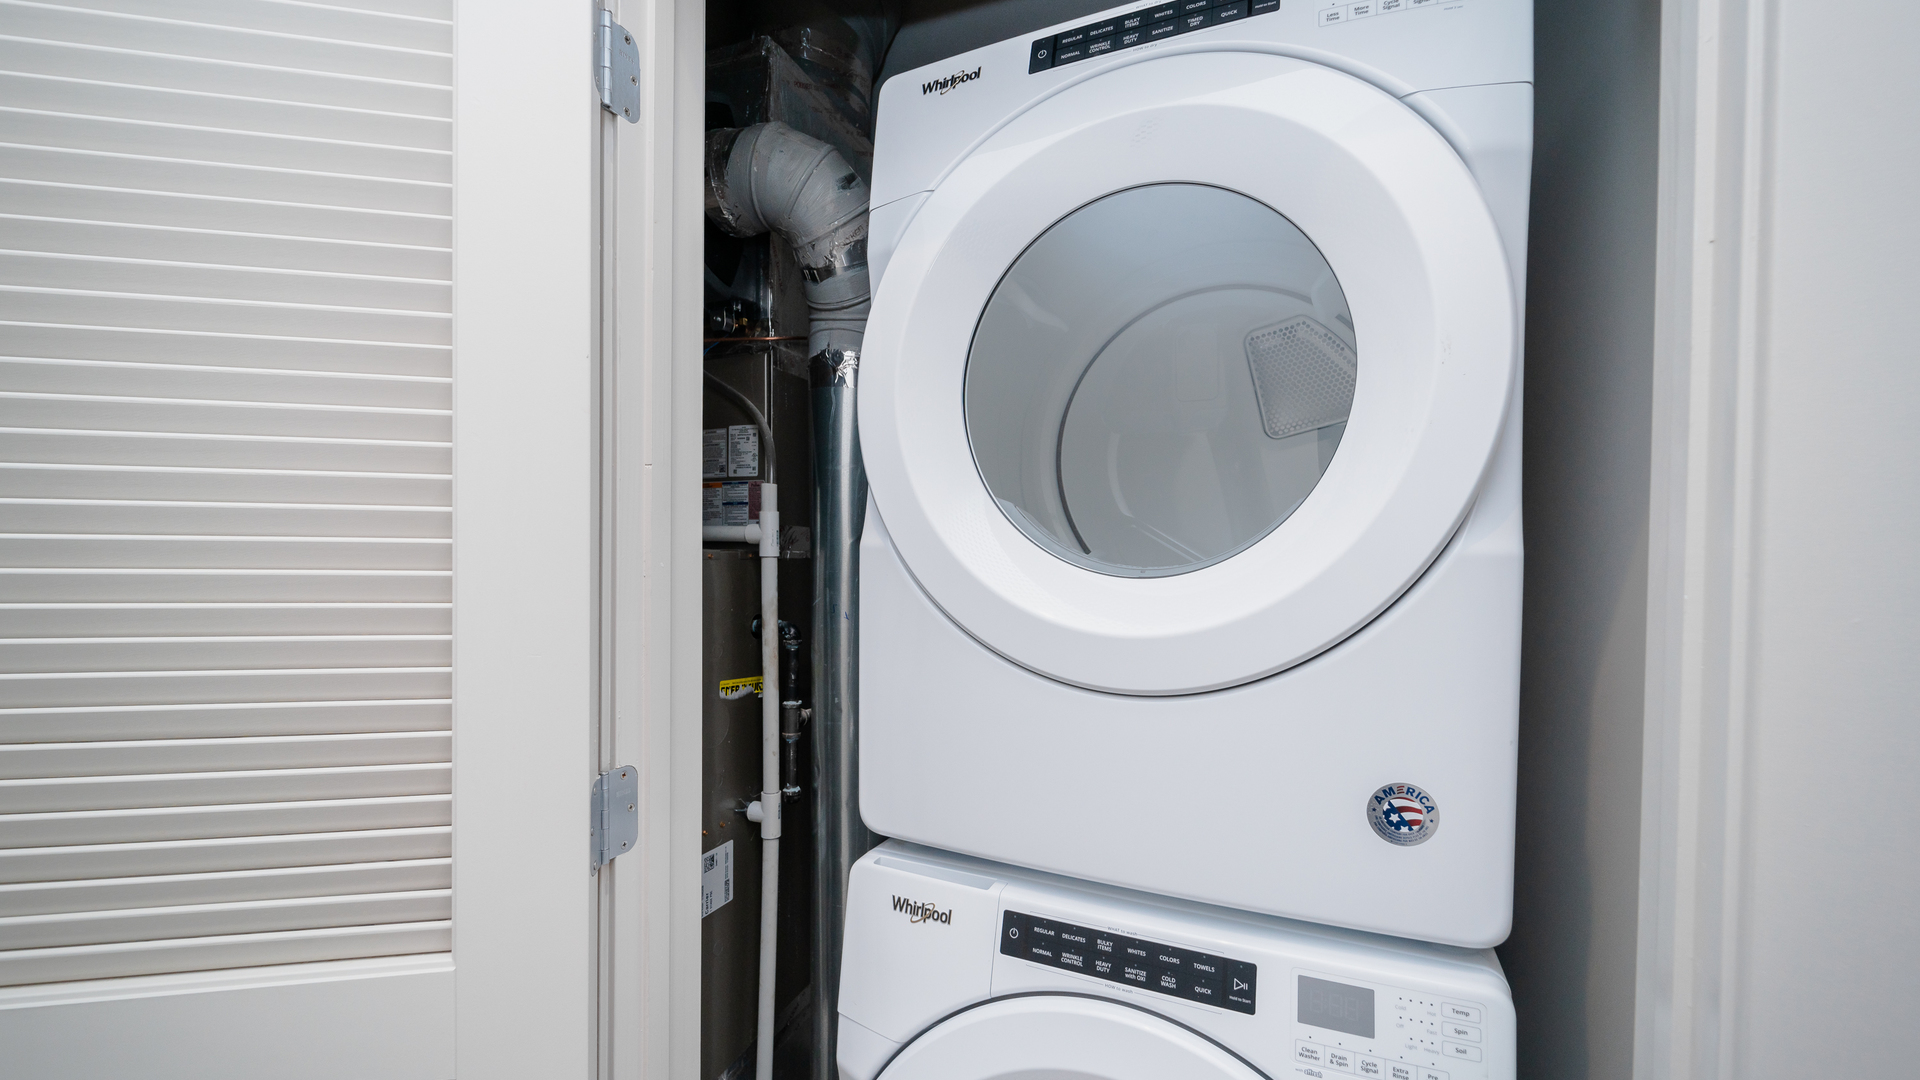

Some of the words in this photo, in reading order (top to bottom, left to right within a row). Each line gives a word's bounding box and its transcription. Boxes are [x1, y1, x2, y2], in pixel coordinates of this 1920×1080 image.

[1185, 0, 1207, 10] COLORS
[1354, 4, 1369, 12] More
[1154, 9, 1173, 18] WHITES
[1220, 9, 1238, 18] QUICK
[1124, 17, 1141, 25] BULKY
[1187, 15, 1204, 24] TIMED
[1124, 21, 1139, 29] ITEMS
[1151, 25, 1174, 35] SANITIZE
[1089, 26, 1114, 36] DELICATES
[1062, 34, 1083, 44] REGULAR
[1122, 33, 1139, 41] HEAVY
[1123, 37, 1138, 45] DUTY
[1088, 44, 1111, 54] CONTROL
[1089, 40, 1111, 50] WRINKLE
[1060, 50, 1081, 60] NORMAL
[922, 66, 982, 96] Whirlpool
[1373, 785, 1435, 815] AMERICA
[892, 894, 952, 926] Whirlpool
[1034, 926, 1055, 937] REGULAR
[1062, 933, 1086, 943] DELICATES
[1097, 938, 1113, 947] BULKY
[1032, 947, 1053, 957] NORMAL
[1097, 944, 1112, 953] ITEMS
[1127, 947, 1146, 957] WHITES
[1061, 952, 1083, 962] WRINKLE
[1159, 954, 1180, 965] COLORS
[1060, 957, 1084, 968] CONTROL
[1095, 960, 1112, 969] HEAVY
[1193, 962, 1215, 973] TOWELS
[1096, 965, 1110, 974] DUTY
[1124, 966, 1147, 977] SANITIZE
[1124, 972, 1136, 980] with
[1161, 975, 1176, 984] COLD
[1160, 980, 1176, 989] WASH
[1194, 985, 1212, 995] QUICK
[1451, 1007, 1470, 1018] Temp
[1426, 1028, 1438, 1036] Fast
[1454, 1027, 1469, 1036] Spin
[1301, 1045, 1318, 1056] Clean
[1404, 1043, 1418, 1051] Light
[1423, 1046, 1440, 1056] Heavy
[1455, 1046, 1468, 1055] Soil
[1298, 1051, 1321, 1062] Washer
[1330, 1052, 1348, 1062] Drain
[1335, 1058, 1349, 1068] Spin
[1361, 1059, 1378, 1069] Cycle
[1360, 1065, 1379, 1075] Signal
[1392, 1066, 1409, 1075] Extra
[1392, 1072, 1410, 1080] Rinse
